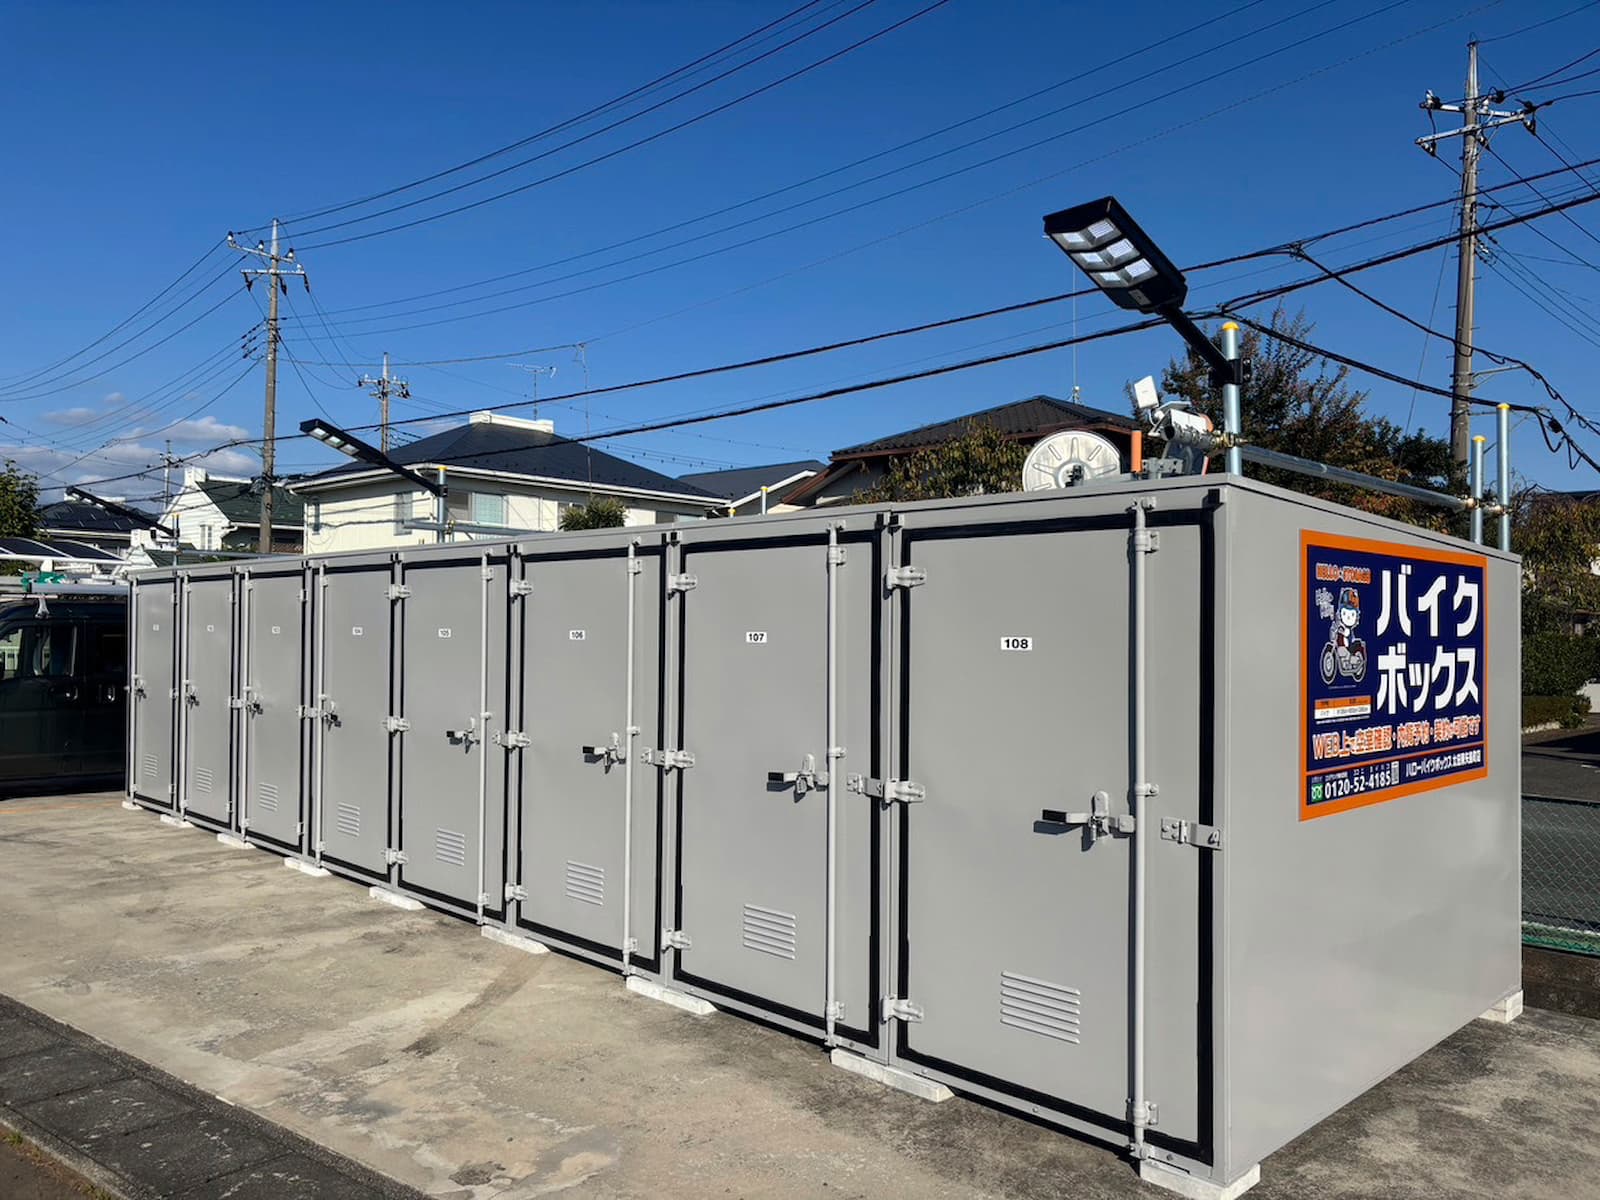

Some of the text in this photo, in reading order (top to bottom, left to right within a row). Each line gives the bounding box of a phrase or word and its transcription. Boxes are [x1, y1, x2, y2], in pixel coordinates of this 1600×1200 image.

[1377, 564, 1479, 637] バイク
[571, 631, 584, 639] 106
[748, 632, 765, 642] 107
[1003, 638, 1029, 649] 108
[1377, 643, 1479, 714] ボックス
[1325, 770, 1391, 799] 0120-52-4185
